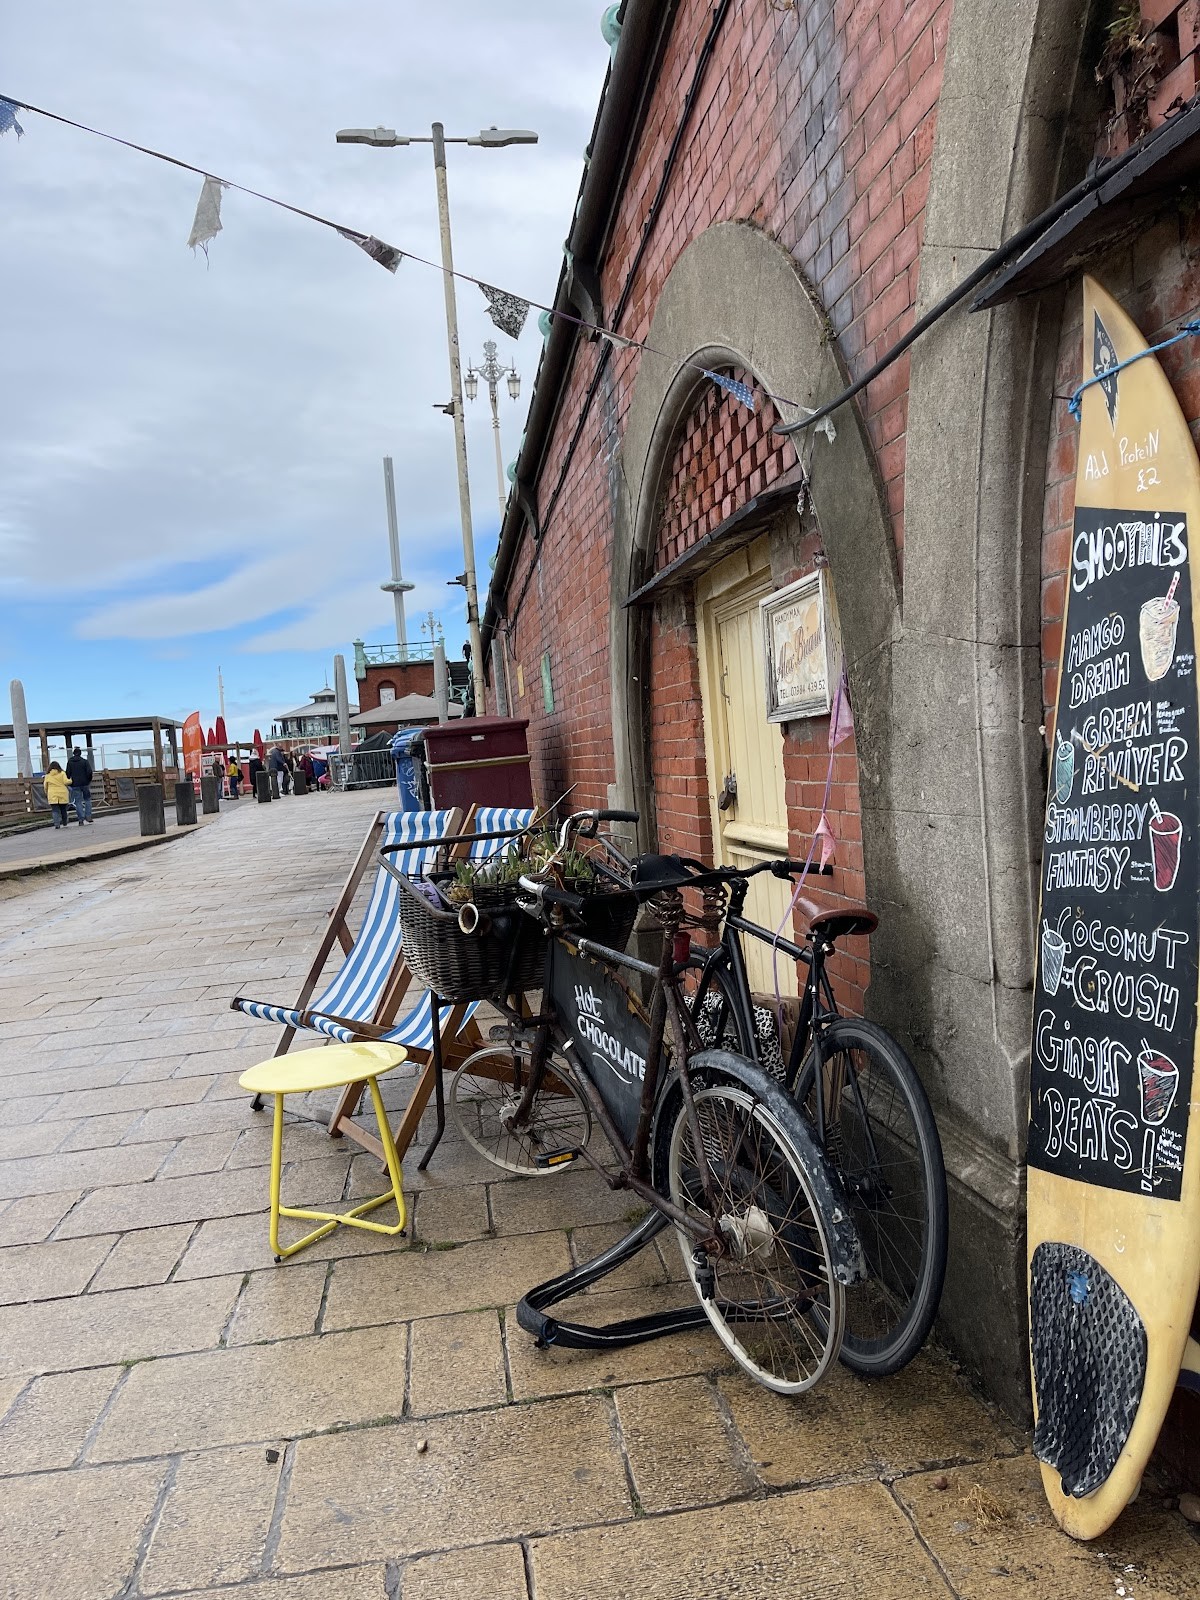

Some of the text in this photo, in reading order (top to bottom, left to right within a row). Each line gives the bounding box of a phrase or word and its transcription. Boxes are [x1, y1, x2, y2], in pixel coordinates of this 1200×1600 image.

[1085, 451, 1110, 481] Add
[1136, 468, 1161, 493] £2
[1067, 614, 1125, 673] MANGO
[1069, 652, 1130, 710] DREAM
[1082, 700, 1152, 752] GREEN
[1045, 802, 1149, 843] STRAWBERRY
[1046, 846, 1131, 893] FANTASY
[1056, 906, 1189, 970] COCONUT
[1071, 955, 1180, 1032] CRUSH
[577, 1014, 646, 1082] CHOCOLATE
